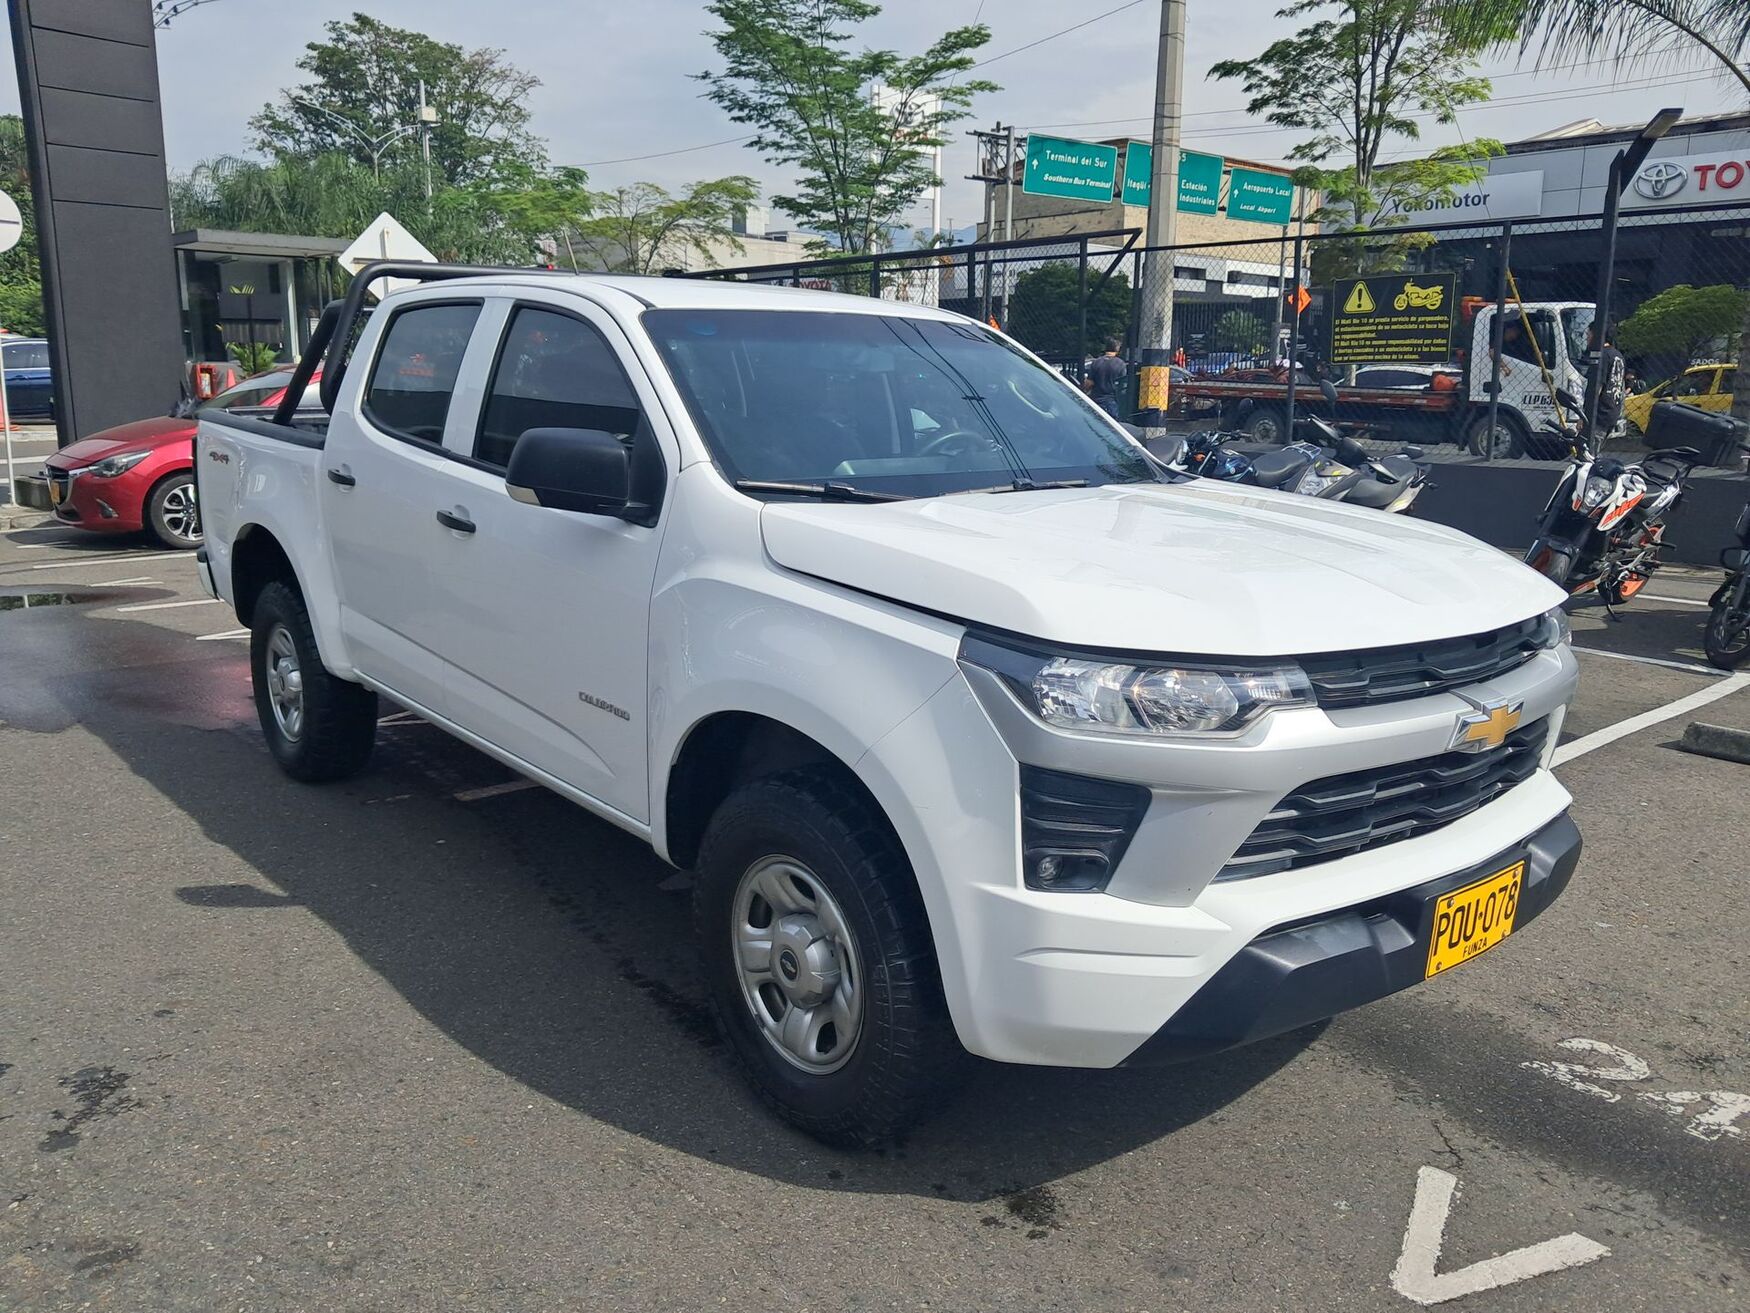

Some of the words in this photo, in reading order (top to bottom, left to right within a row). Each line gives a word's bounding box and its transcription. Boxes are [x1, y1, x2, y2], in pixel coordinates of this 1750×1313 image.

[1045, 150, 1079, 164] Terminal
[1080, 156, 1092, 166] del
[1094, 157, 1107, 168] Sur
[1043, 173, 1073, 184] Southern
[1073, 177, 1085, 186] Bus
[1085, 178, 1112, 189] Terminal
[1242, 181, 1274, 194] Aeropuerto
[1275, 186, 1291, 197] Local
[1179, 193, 1215, 206] Industriales
[1240, 203, 1256, 211] Local
[1462, 937, 1488, 957] FUNZA
